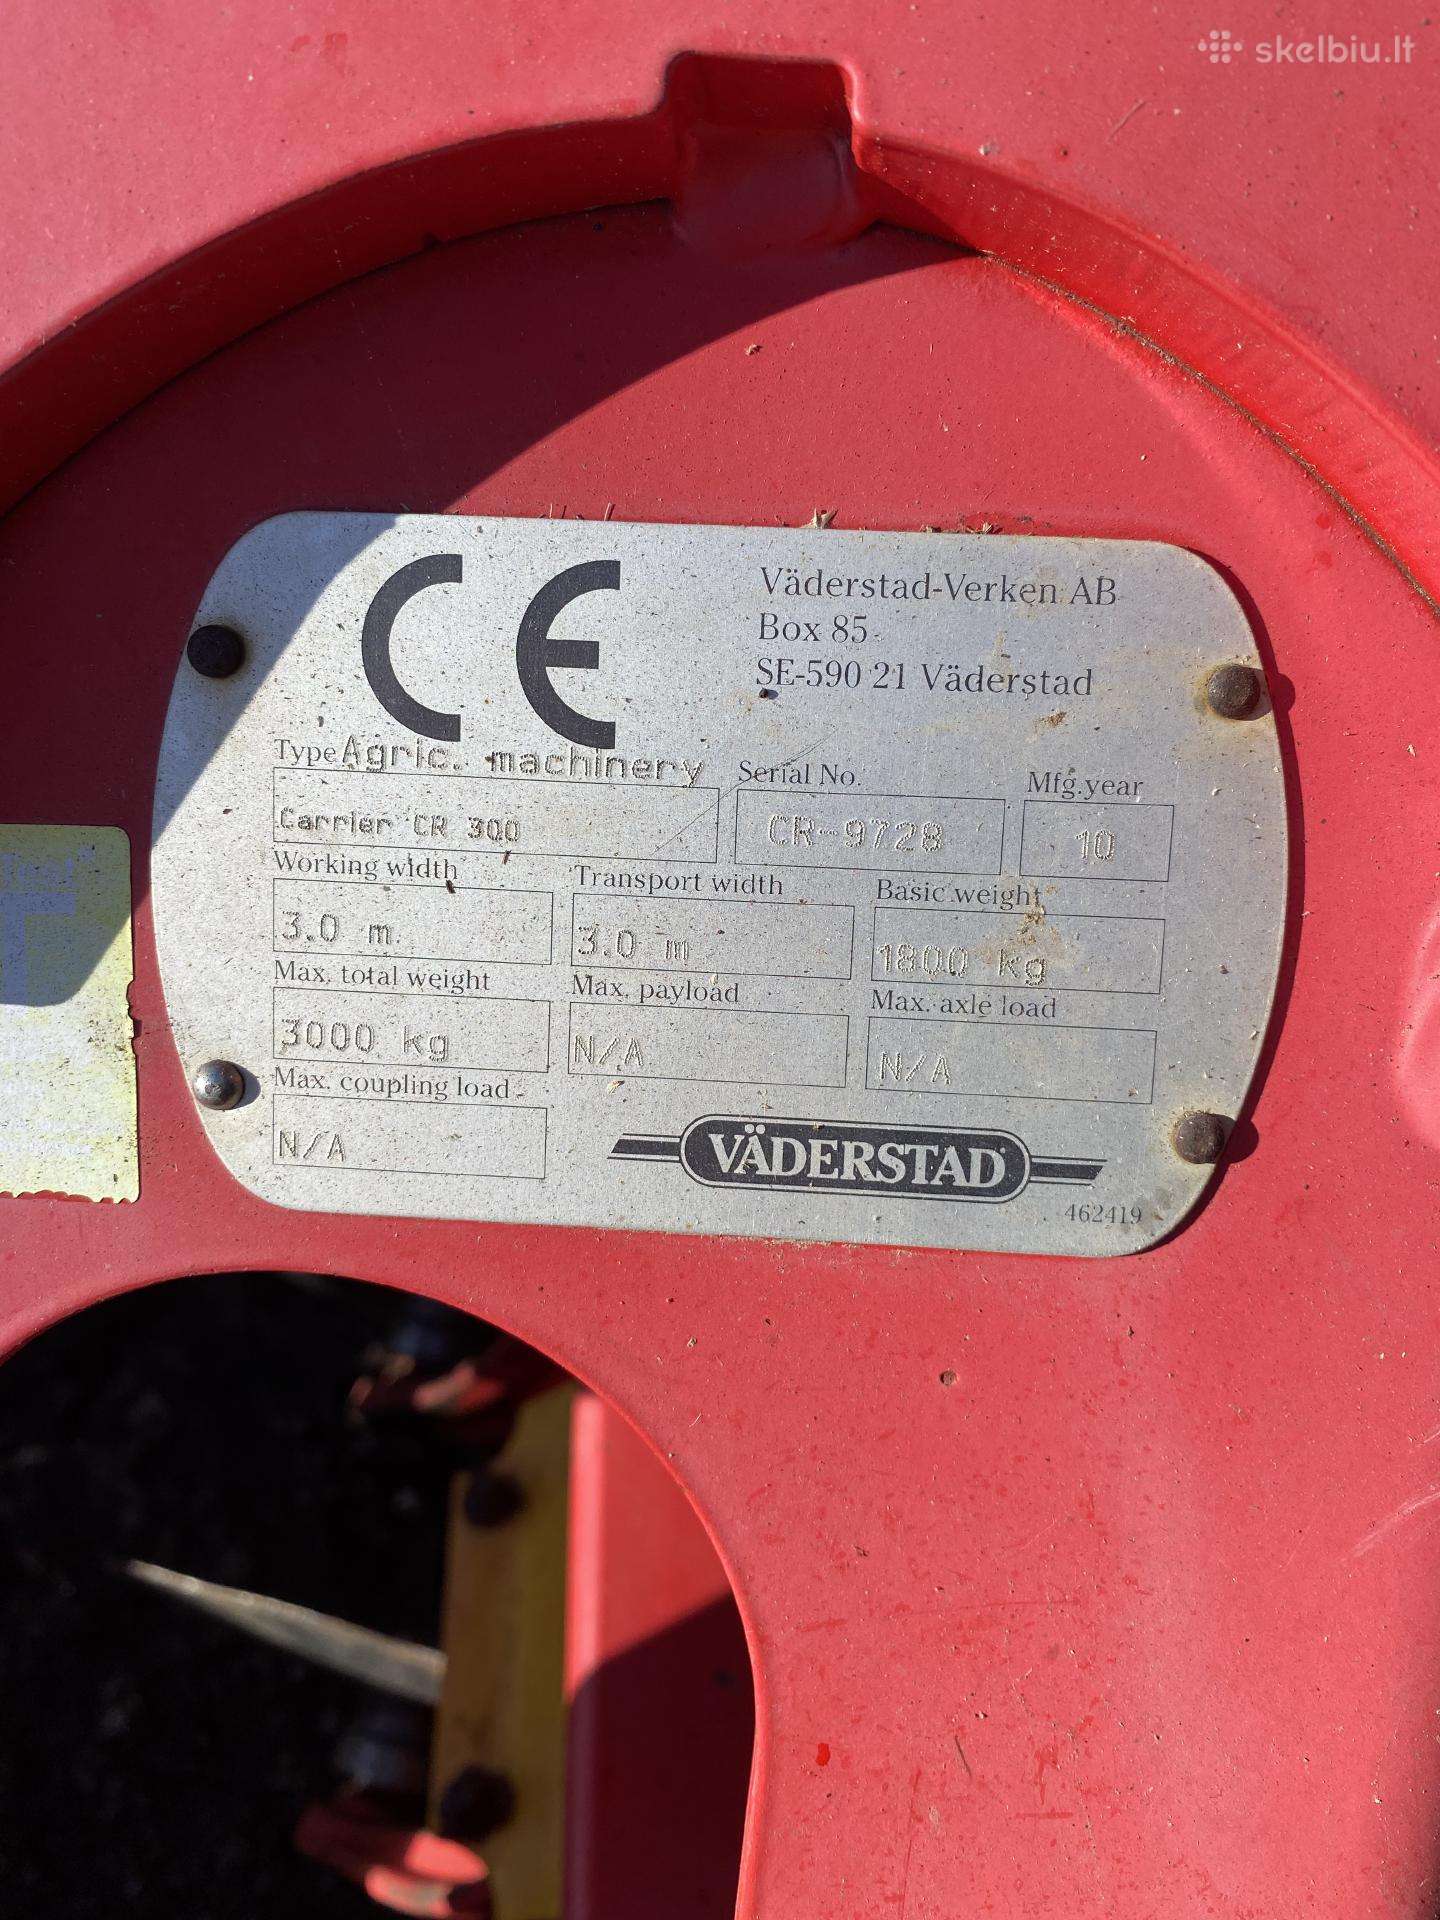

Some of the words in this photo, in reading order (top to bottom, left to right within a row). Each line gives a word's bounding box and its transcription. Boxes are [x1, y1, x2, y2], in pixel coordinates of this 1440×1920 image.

[760, 567, 1058, 604] Väderstad-Verken
[1070, 577, 1117, 606] AB
[758, 613, 820, 643] Box
[832, 615, 868, 643] 85
[756, 659, 861, 689] SE-590
[873, 662, 906, 690] 21
[921, 664, 1092, 696] Väderstad
[274, 739, 336, 768] Type
[342, 734, 463, 773] Agric.
[489, 749, 704, 787] machinery
[738, 760, 812, 785] Serial
[820, 764, 862, 787] No.
[1027, 771, 1143, 799] Mfg.year
[279, 808, 393, 835] Carrier
[413, 813, 448, 838] CR
[468, 817, 520, 842] 300
[1075, 830, 1115, 861] 10
[274, 850, 379, 881] Working
[386, 857, 458, 881] width
[576, 865, 700, 895] Transport
[711, 875, 783, 896] width
[876, 880, 945, 902] Basic
[954, 884, 1041, 910] weight
[281, 910, 339, 942] 3.0
[576, 926, 636, 959] 3.0
[664, 938, 689, 961] m
[274, 960, 331, 983] Max.
[341, 964, 398, 986] total
[407, 967, 490, 995] weight
[878, 944, 968, 978] 1800
[999, 955, 1047, 986] kg
[572, 975, 629, 998] Max.
[640, 978, 740, 1008] payload
[871, 990, 929, 1012] Max.
[939, 992, 992, 1016] axle
[1001, 995, 1056, 1018] load
[280, 1019, 374, 1053] 3000
[403, 1025, 449, 1061] kg
[575, 1035, 643, 1067] N/A
[880, 1052, 952, 1084] N/A
[275, 1067, 331, 1090] Max.
[340, 1069, 448, 1102] coupling
[457, 1076, 509, 1099] load
[279, 1129, 346, 1161] N/A
[708, 1123, 1006, 1187] VÄDERSTAD
[1065, 1204, 1142, 1225] 462419
